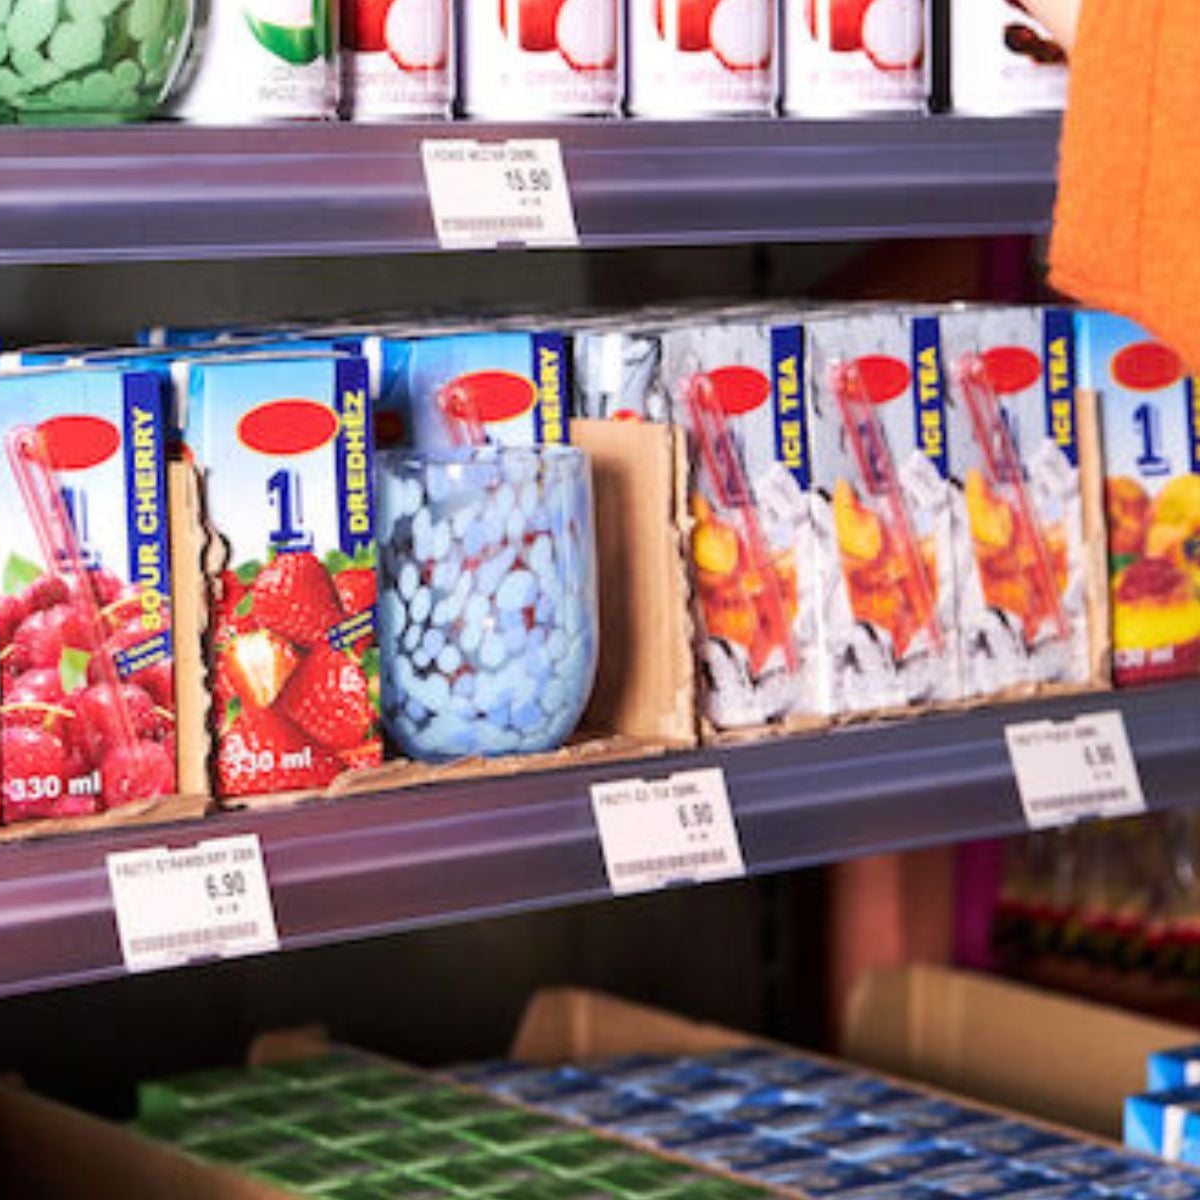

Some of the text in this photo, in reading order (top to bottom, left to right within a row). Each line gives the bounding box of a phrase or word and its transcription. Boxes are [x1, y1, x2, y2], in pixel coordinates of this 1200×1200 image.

[538, 346, 563, 446] BERRY
[777, 354, 802, 469] ICE TEA
[917, 345, 943, 458] ICE TEA
[1049, 337, 1072, 447] ICE TEA
[131, 405, 160, 536] CHERRY
[136, 541, 163, 631] SOUR
[67, 771, 101, 794] ml
[280, 746, 312, 768] ml
[205, 869, 247, 900] 6.90
